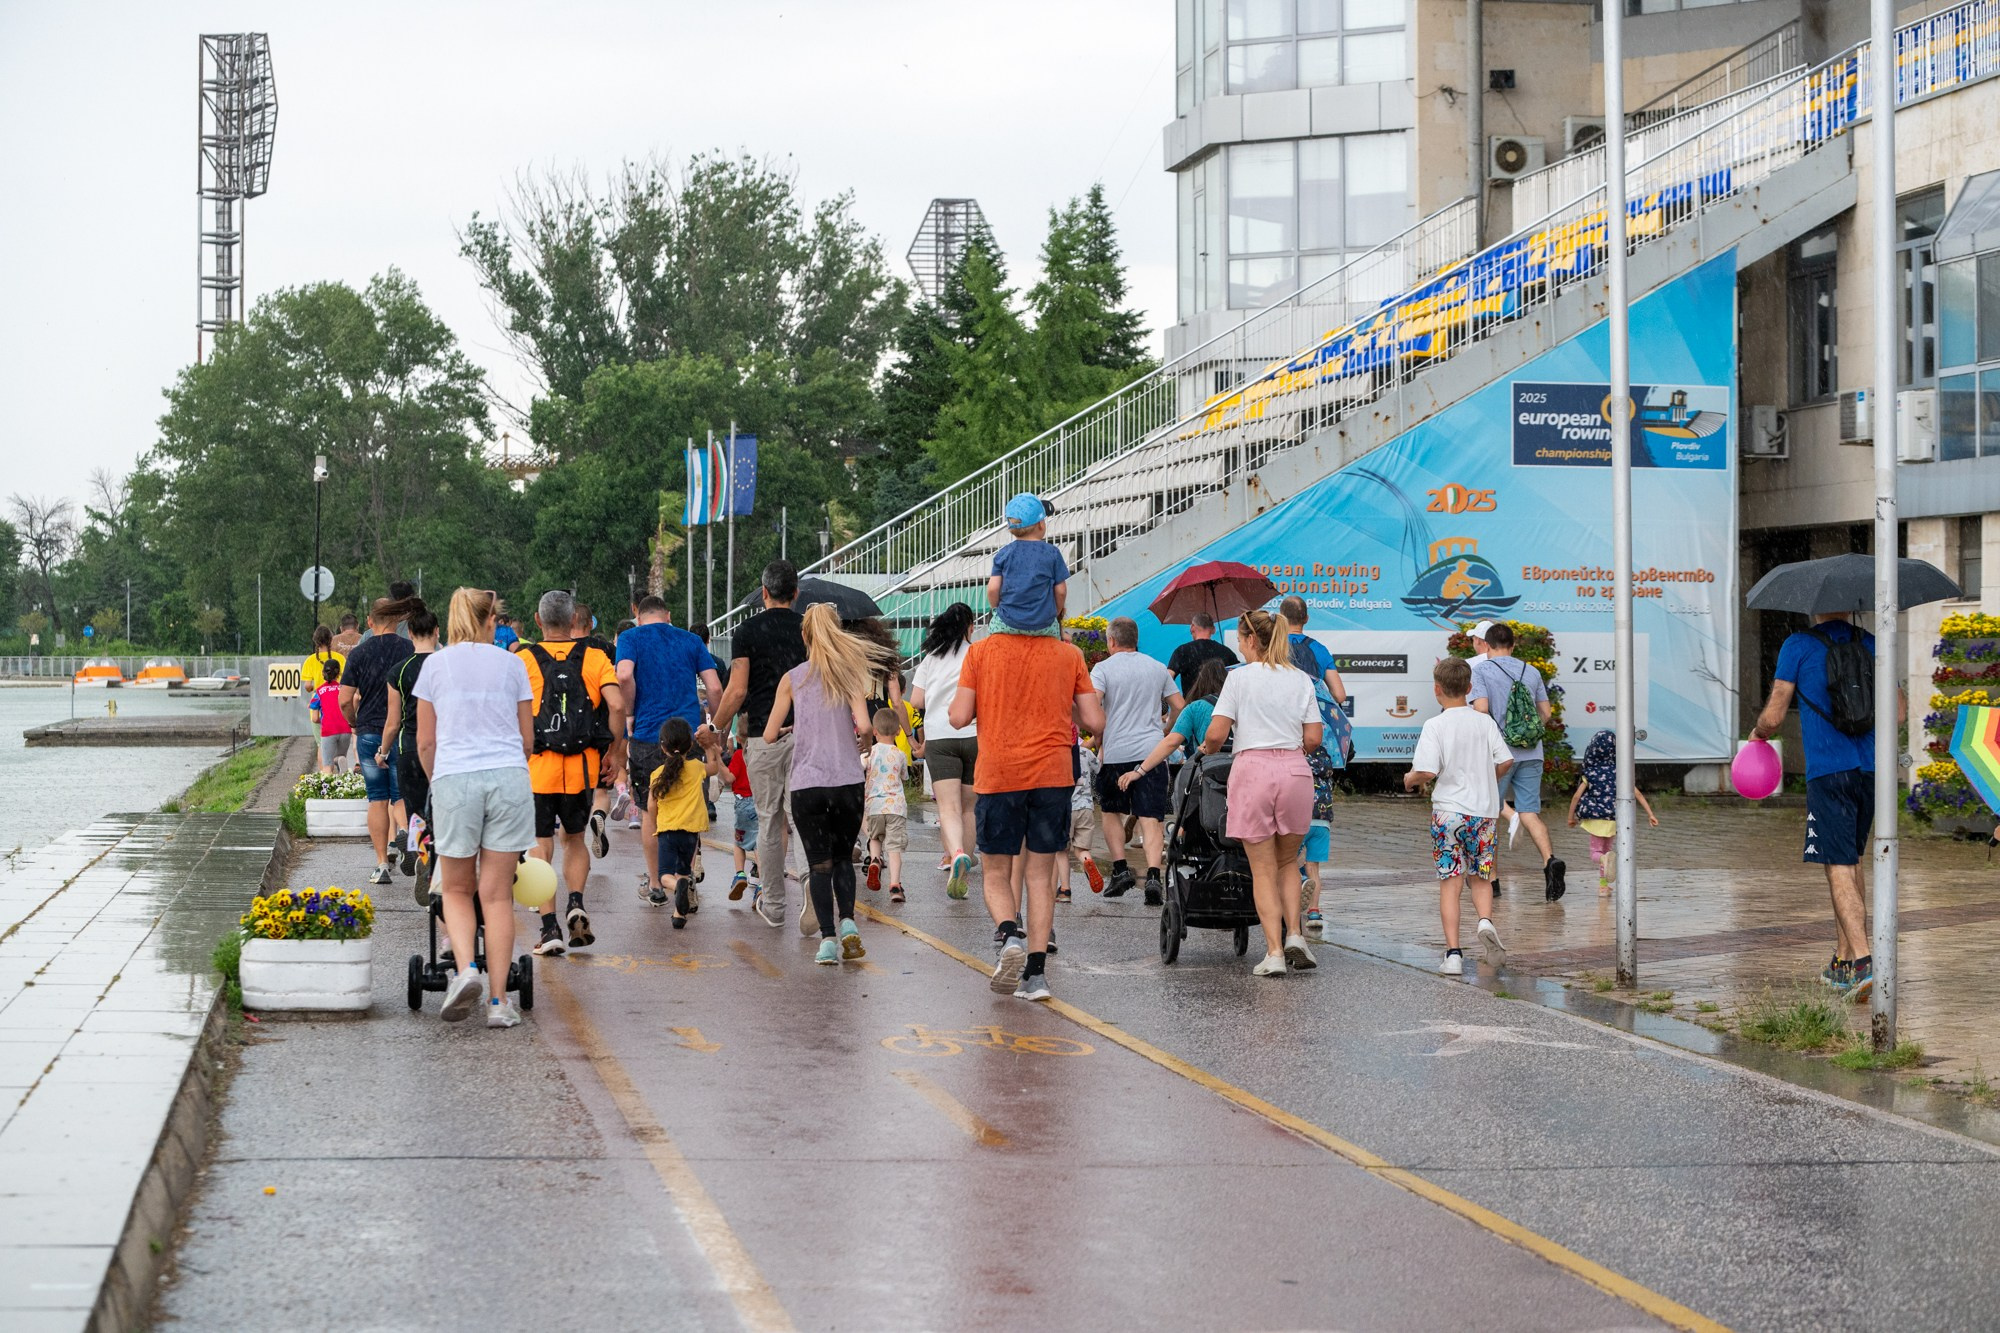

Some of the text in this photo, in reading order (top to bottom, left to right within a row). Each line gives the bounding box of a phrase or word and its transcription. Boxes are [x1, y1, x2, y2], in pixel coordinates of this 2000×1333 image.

[1519, 392, 1547, 404] 2025
[1518, 412, 1601, 429] european
[1561, 427, 1612, 445] rowin
[1671, 441, 1701, 450] Plovdiv
[1535, 447, 1612, 461] championship
[1675, 451, 1710, 462] Bulgaria
[1426, 482, 1497, 514] 2025
[1312, 561, 1381, 581] Rowing
[1522, 565, 1715, 584] Европейско ървенство
[1576, 585, 1596, 598] по
[1306, 598, 1393, 612] Plovdiv, Bulgaria
[1351, 659, 1405, 668] concept 2
[269, 668, 301, 691] 2000
[1598, 704, 1616, 713] spee
